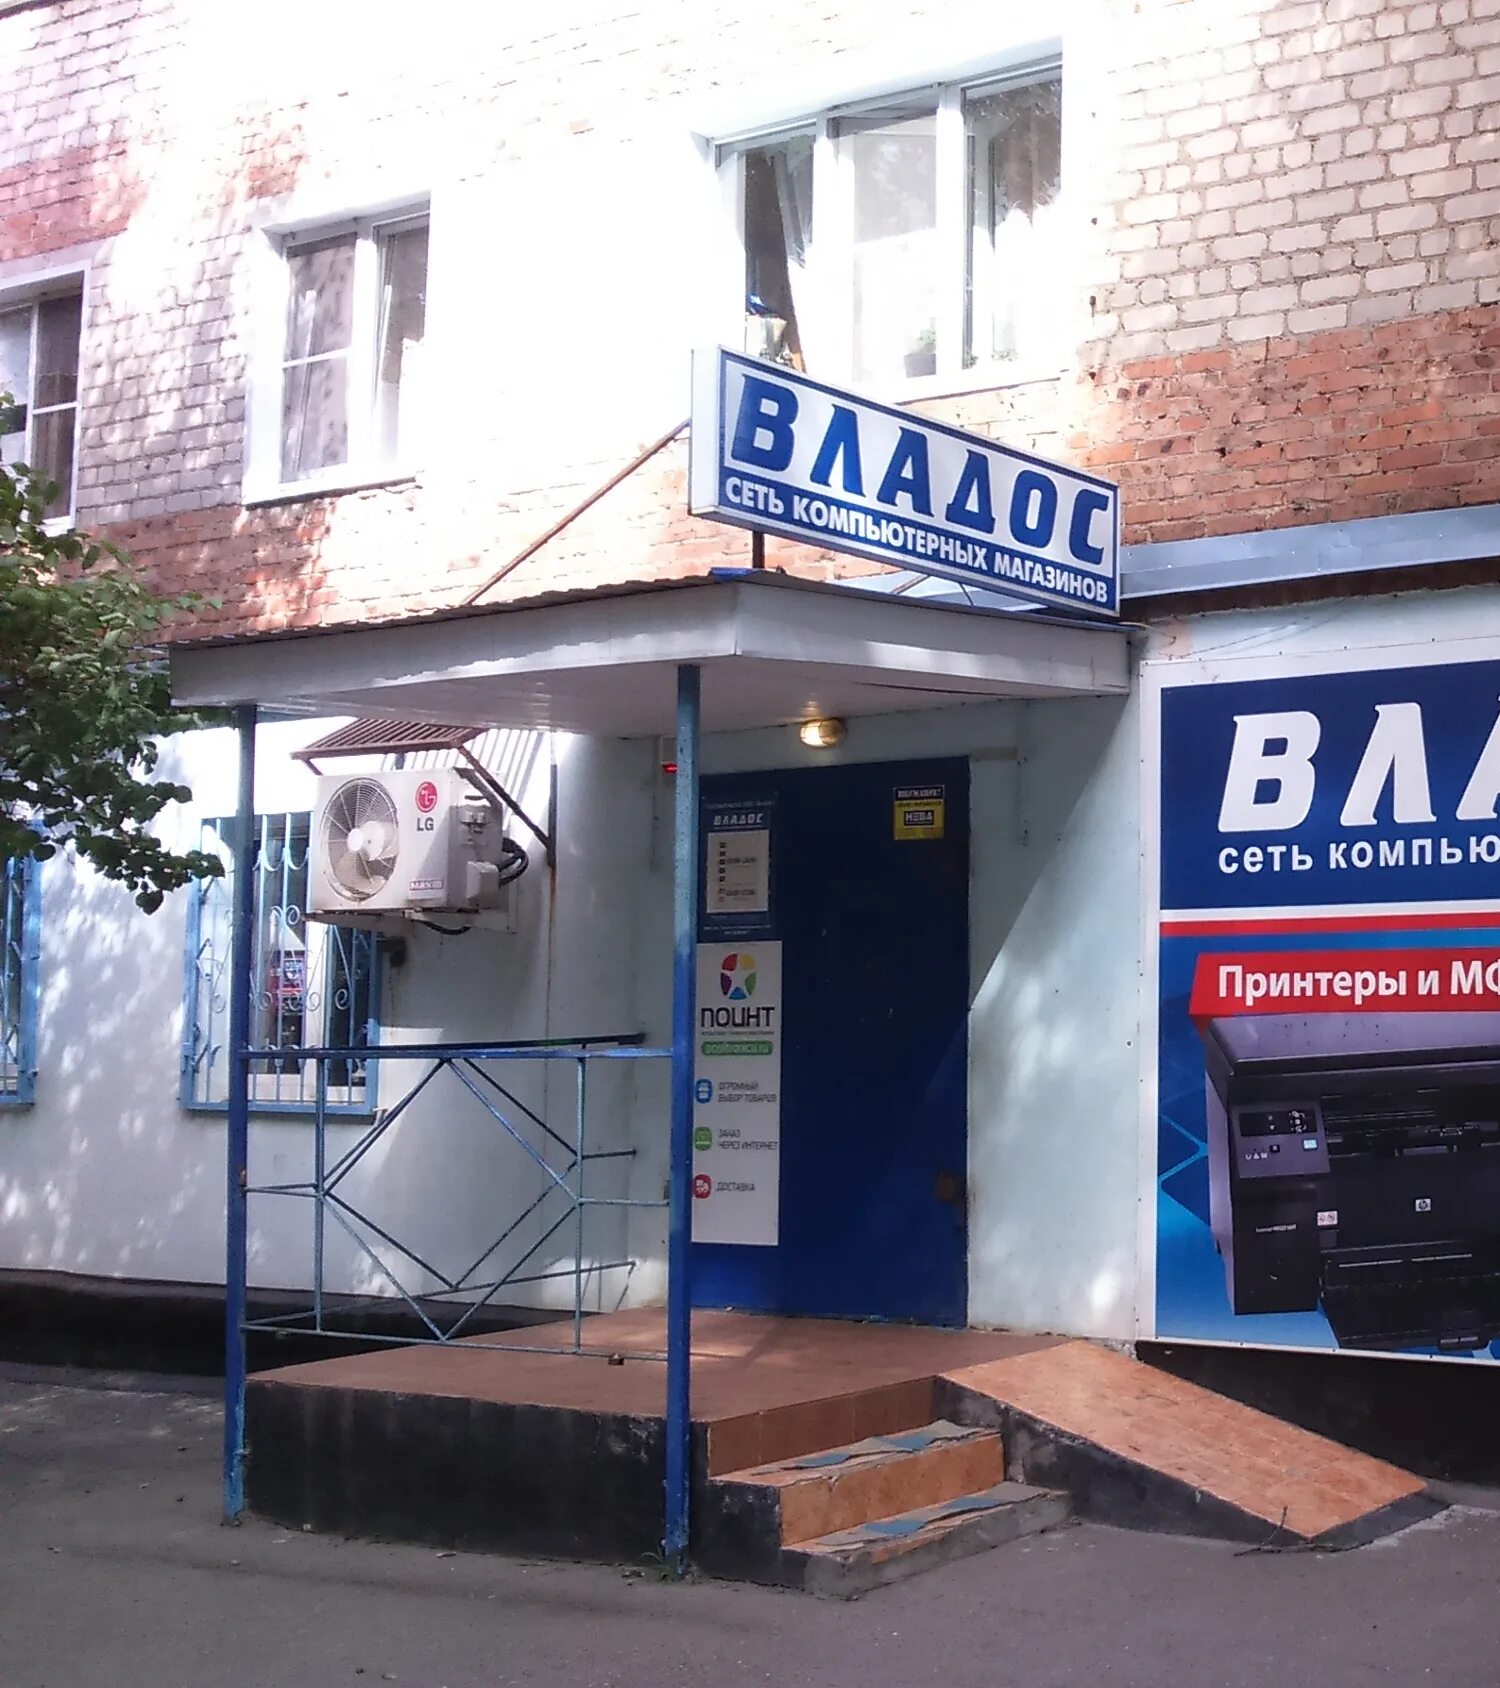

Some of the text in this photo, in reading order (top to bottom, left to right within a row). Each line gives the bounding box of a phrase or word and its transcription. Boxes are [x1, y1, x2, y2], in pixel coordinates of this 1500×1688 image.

[731, 373, 1109, 566] ВЛАДОС
[725, 476, 1108, 604] СЕТЬ КОМПЬЮТЕРНЫХ МАГАЗИНОВ
[416, 816, 434, 832] LG
[1218, 841, 1315, 874] сеть
[1217, 964, 1407, 1005] Принтеры
[1417, 968, 1440, 986] и
